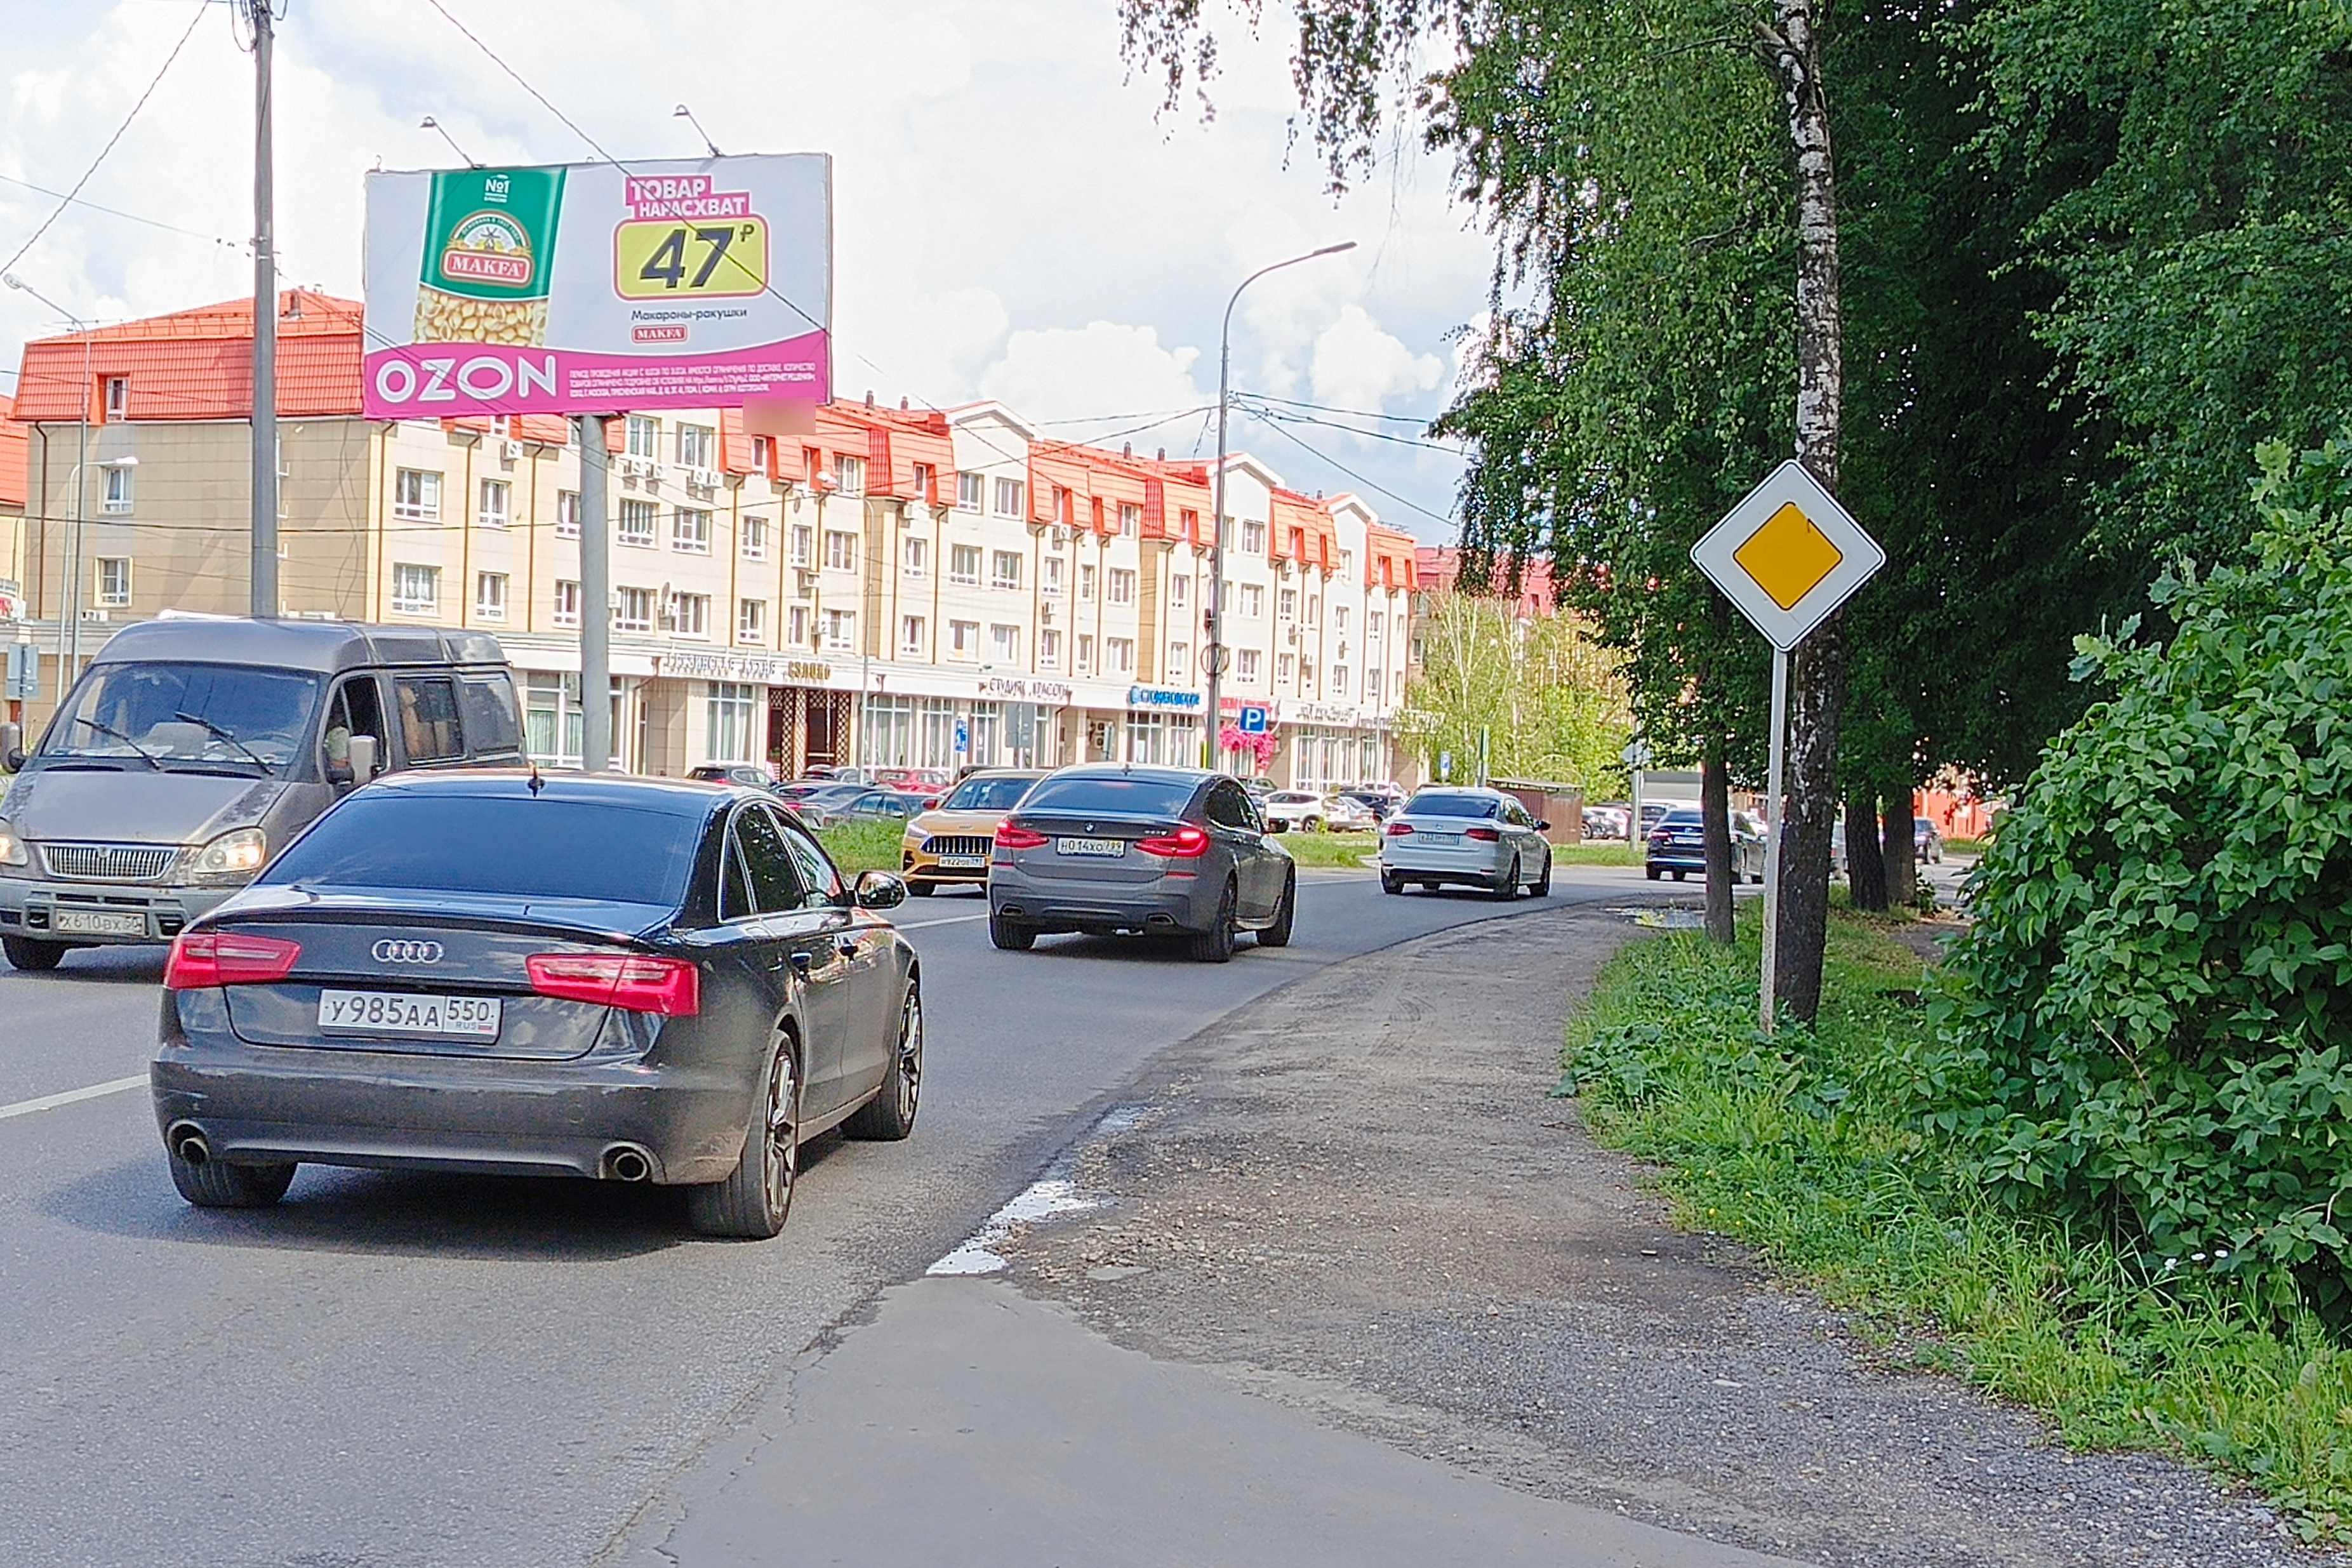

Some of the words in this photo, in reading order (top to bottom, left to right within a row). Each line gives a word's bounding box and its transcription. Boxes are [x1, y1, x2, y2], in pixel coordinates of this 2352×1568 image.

[630, 178, 705, 201] ТОВАР
[639, 197, 747, 217] НАРАСХВАТ
[631, 309, 747, 321] Макароны-ракушки
[376, 354, 556, 404] OZON
[447, 1000, 489, 1021] 550
